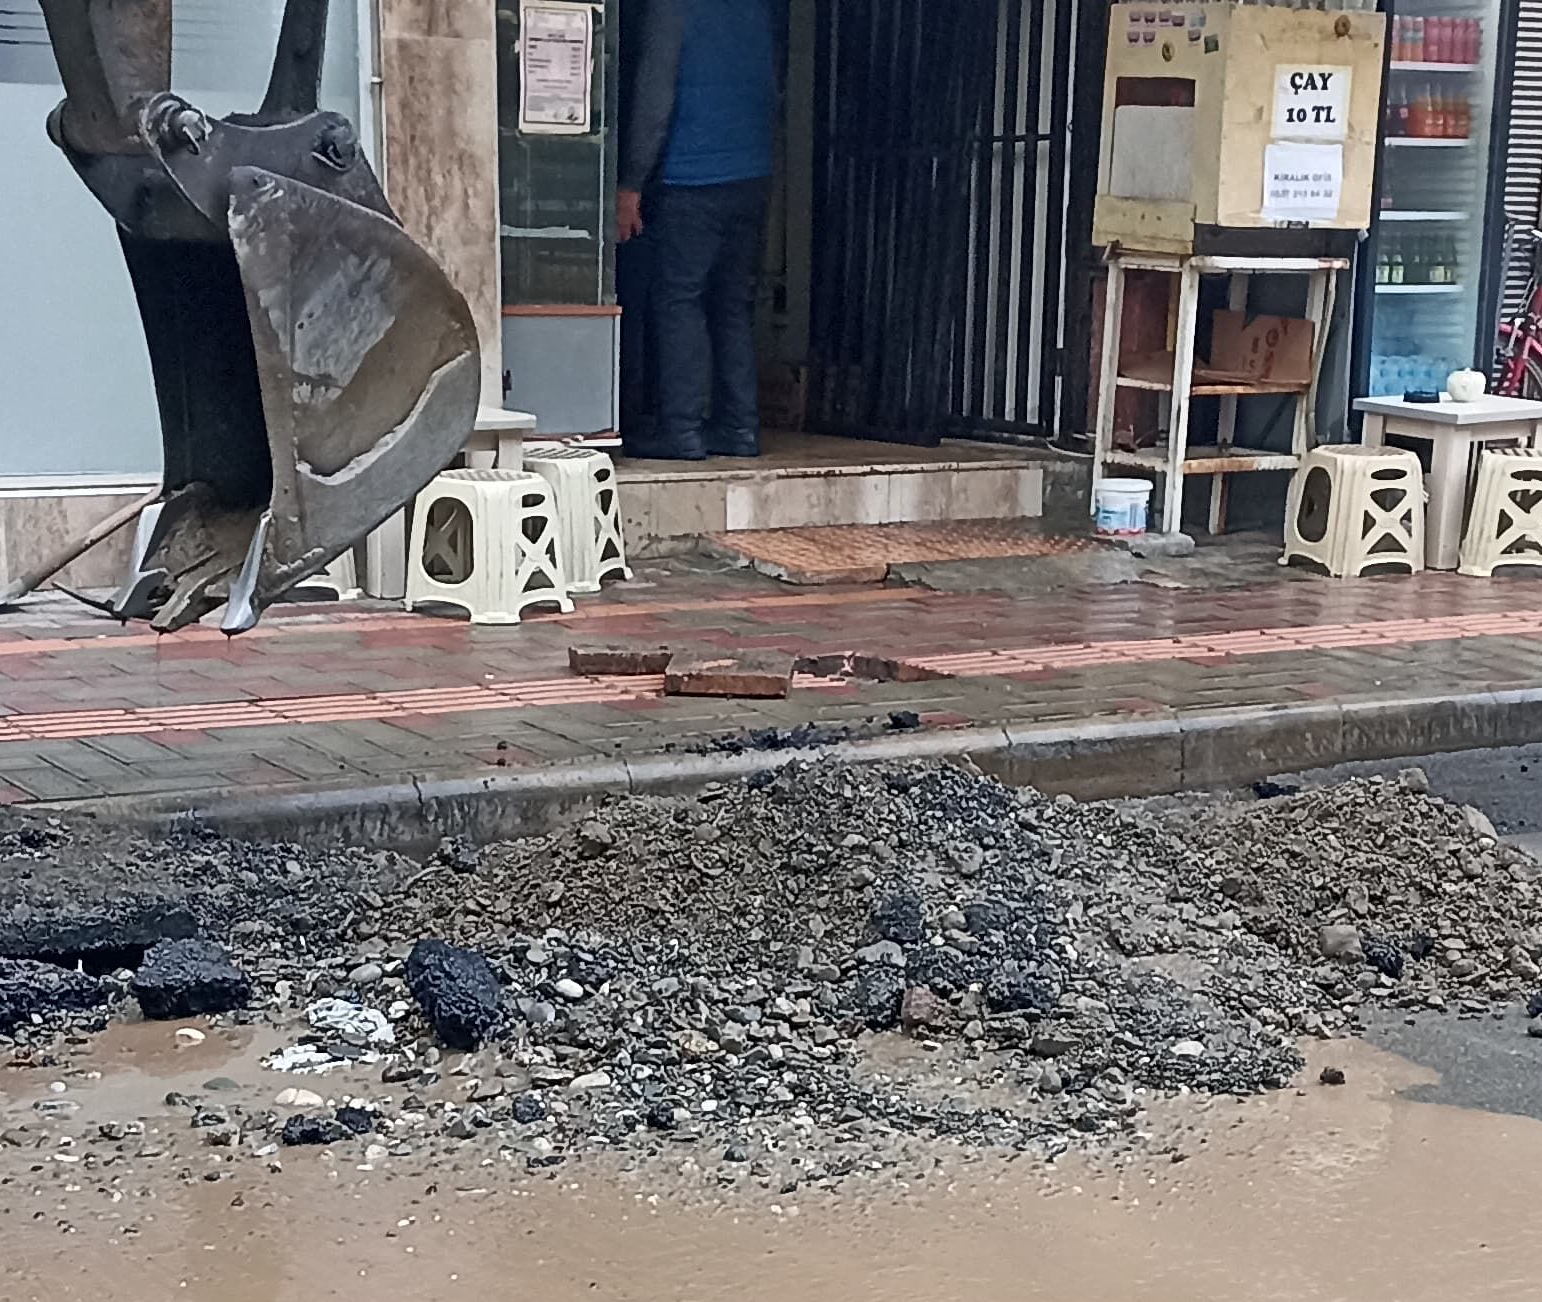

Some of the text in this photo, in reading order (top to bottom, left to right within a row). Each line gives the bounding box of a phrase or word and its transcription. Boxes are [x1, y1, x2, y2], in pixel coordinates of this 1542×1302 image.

[1290, 72, 1334, 95] ÇAY
[1286, 106, 1336, 123] 10 TL
